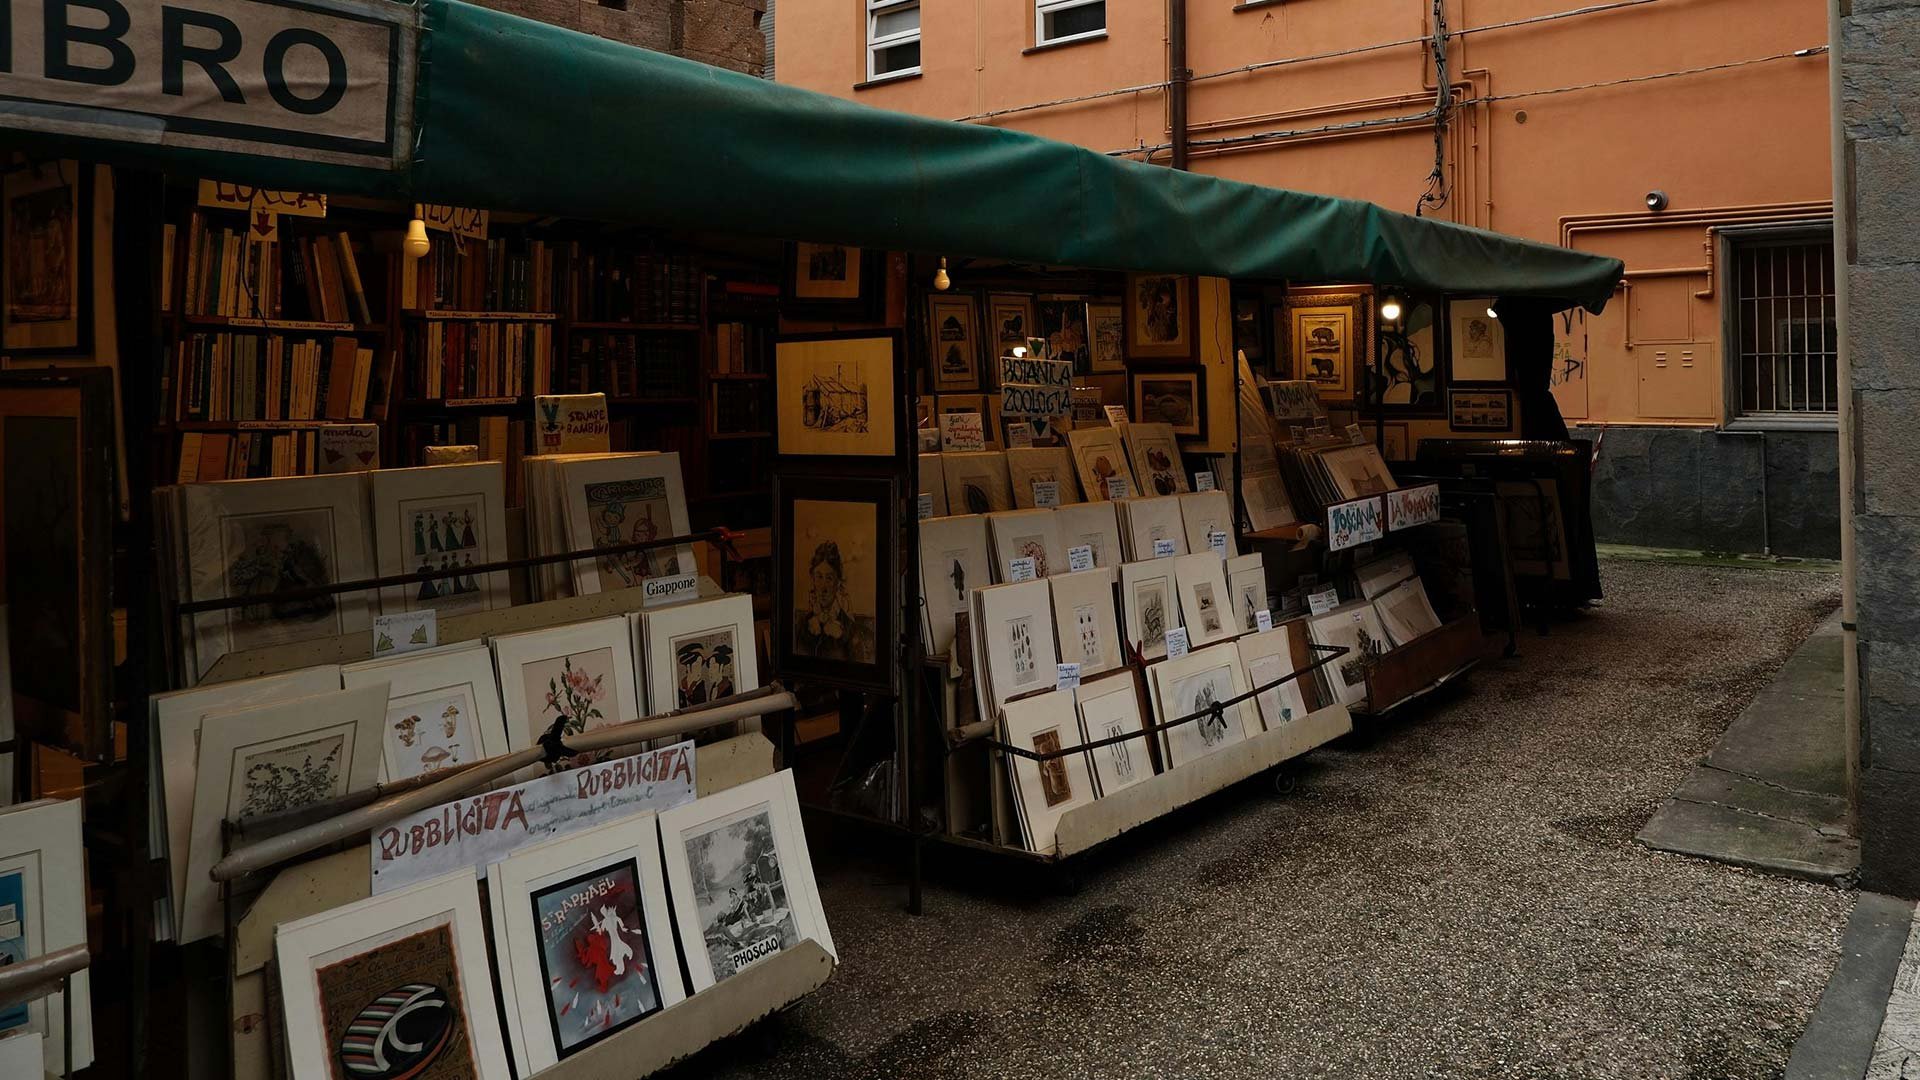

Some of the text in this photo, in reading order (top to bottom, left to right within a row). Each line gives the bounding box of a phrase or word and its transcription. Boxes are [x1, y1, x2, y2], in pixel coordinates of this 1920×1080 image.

[429, 203, 483, 235] LUCCA
[1003, 359, 1071, 387] BOTANICA
[1003, 387, 1072, 414] ZOOLOGIA
[566, 421, 609, 434] BAMBINI
[1333, 501, 1377, 535] TOSCANA
[646, 578, 696, 596] Giappone
[733, 937, 779, 968] PHOSCAO
